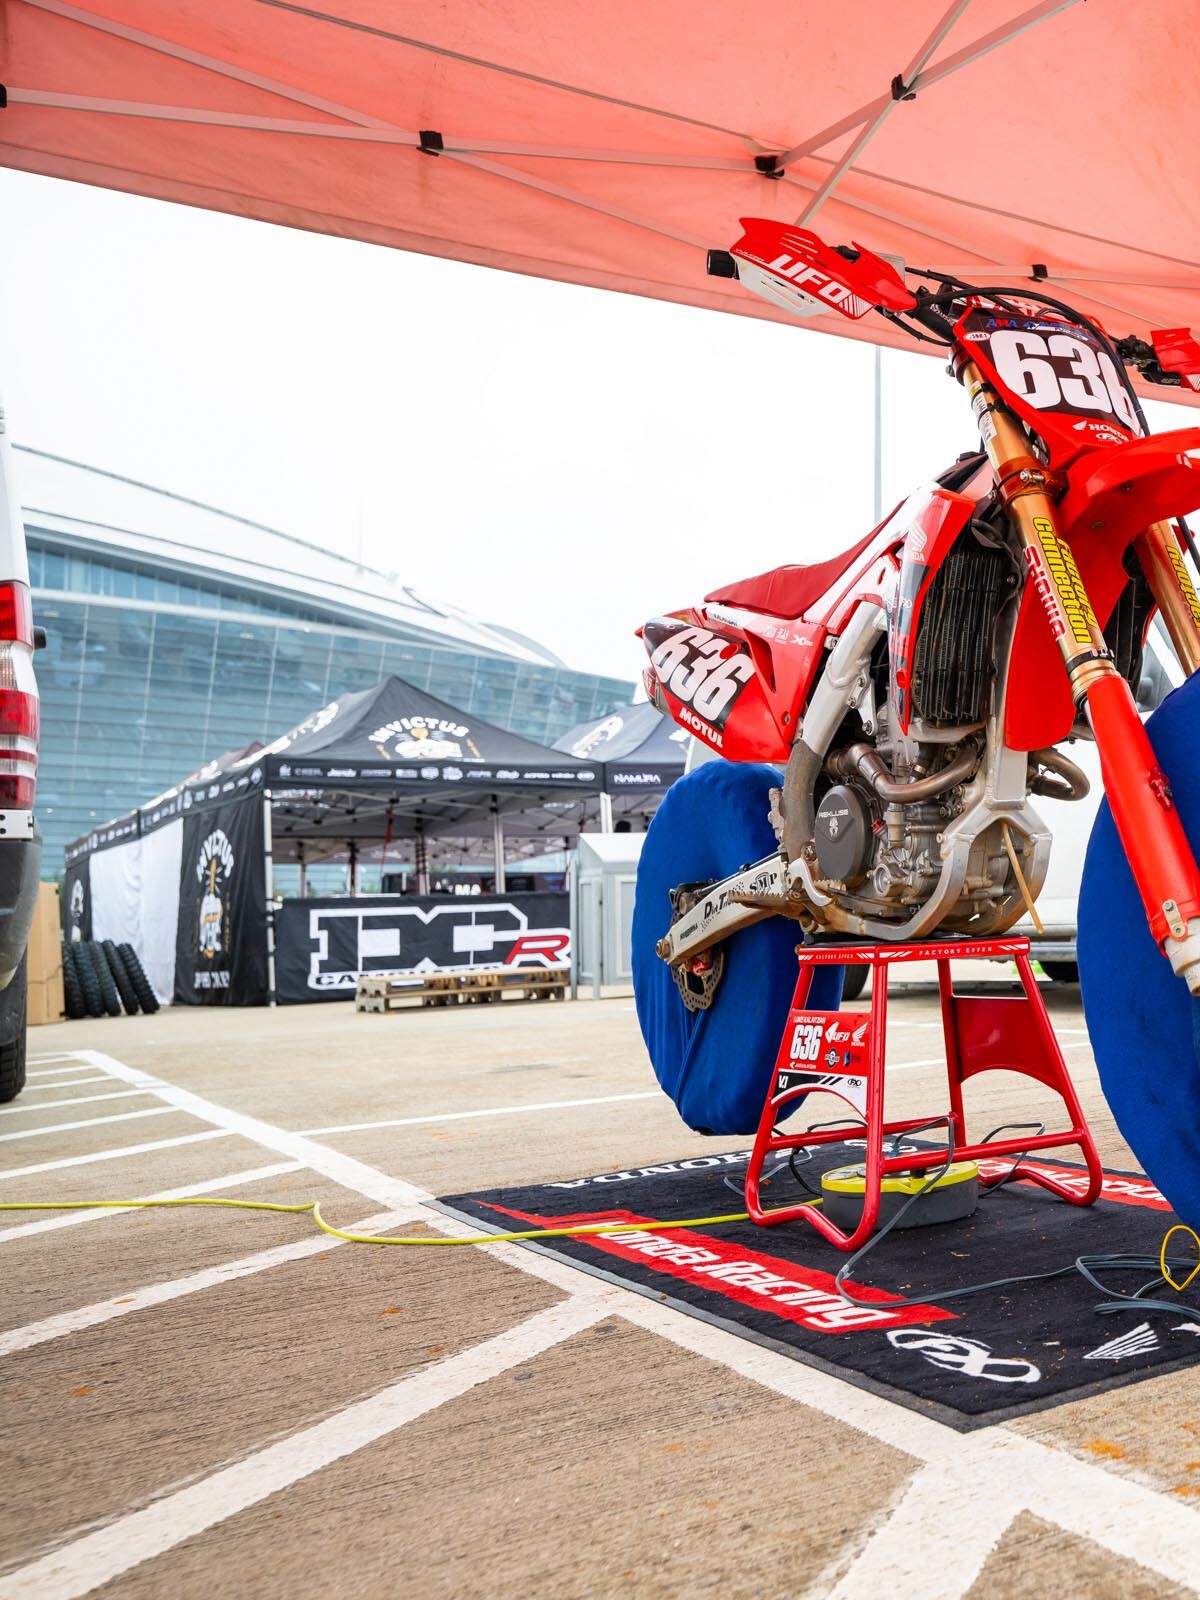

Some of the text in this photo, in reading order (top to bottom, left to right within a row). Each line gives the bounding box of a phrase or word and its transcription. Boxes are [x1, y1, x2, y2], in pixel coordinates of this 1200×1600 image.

[767, 254, 852, 304] UFO
[1033, 517, 1093, 643] Connection
[651, 626, 757, 721] 636
[368, 716, 470, 743] INVICTUS
[680, 707, 723, 748] MOTUL
[920, 946, 992, 956] FACTORY EFFEX
[790, 1024, 823, 1061] 636
[833, 1031, 850, 1041] UFO
[693, 1261, 902, 1330] Racing
